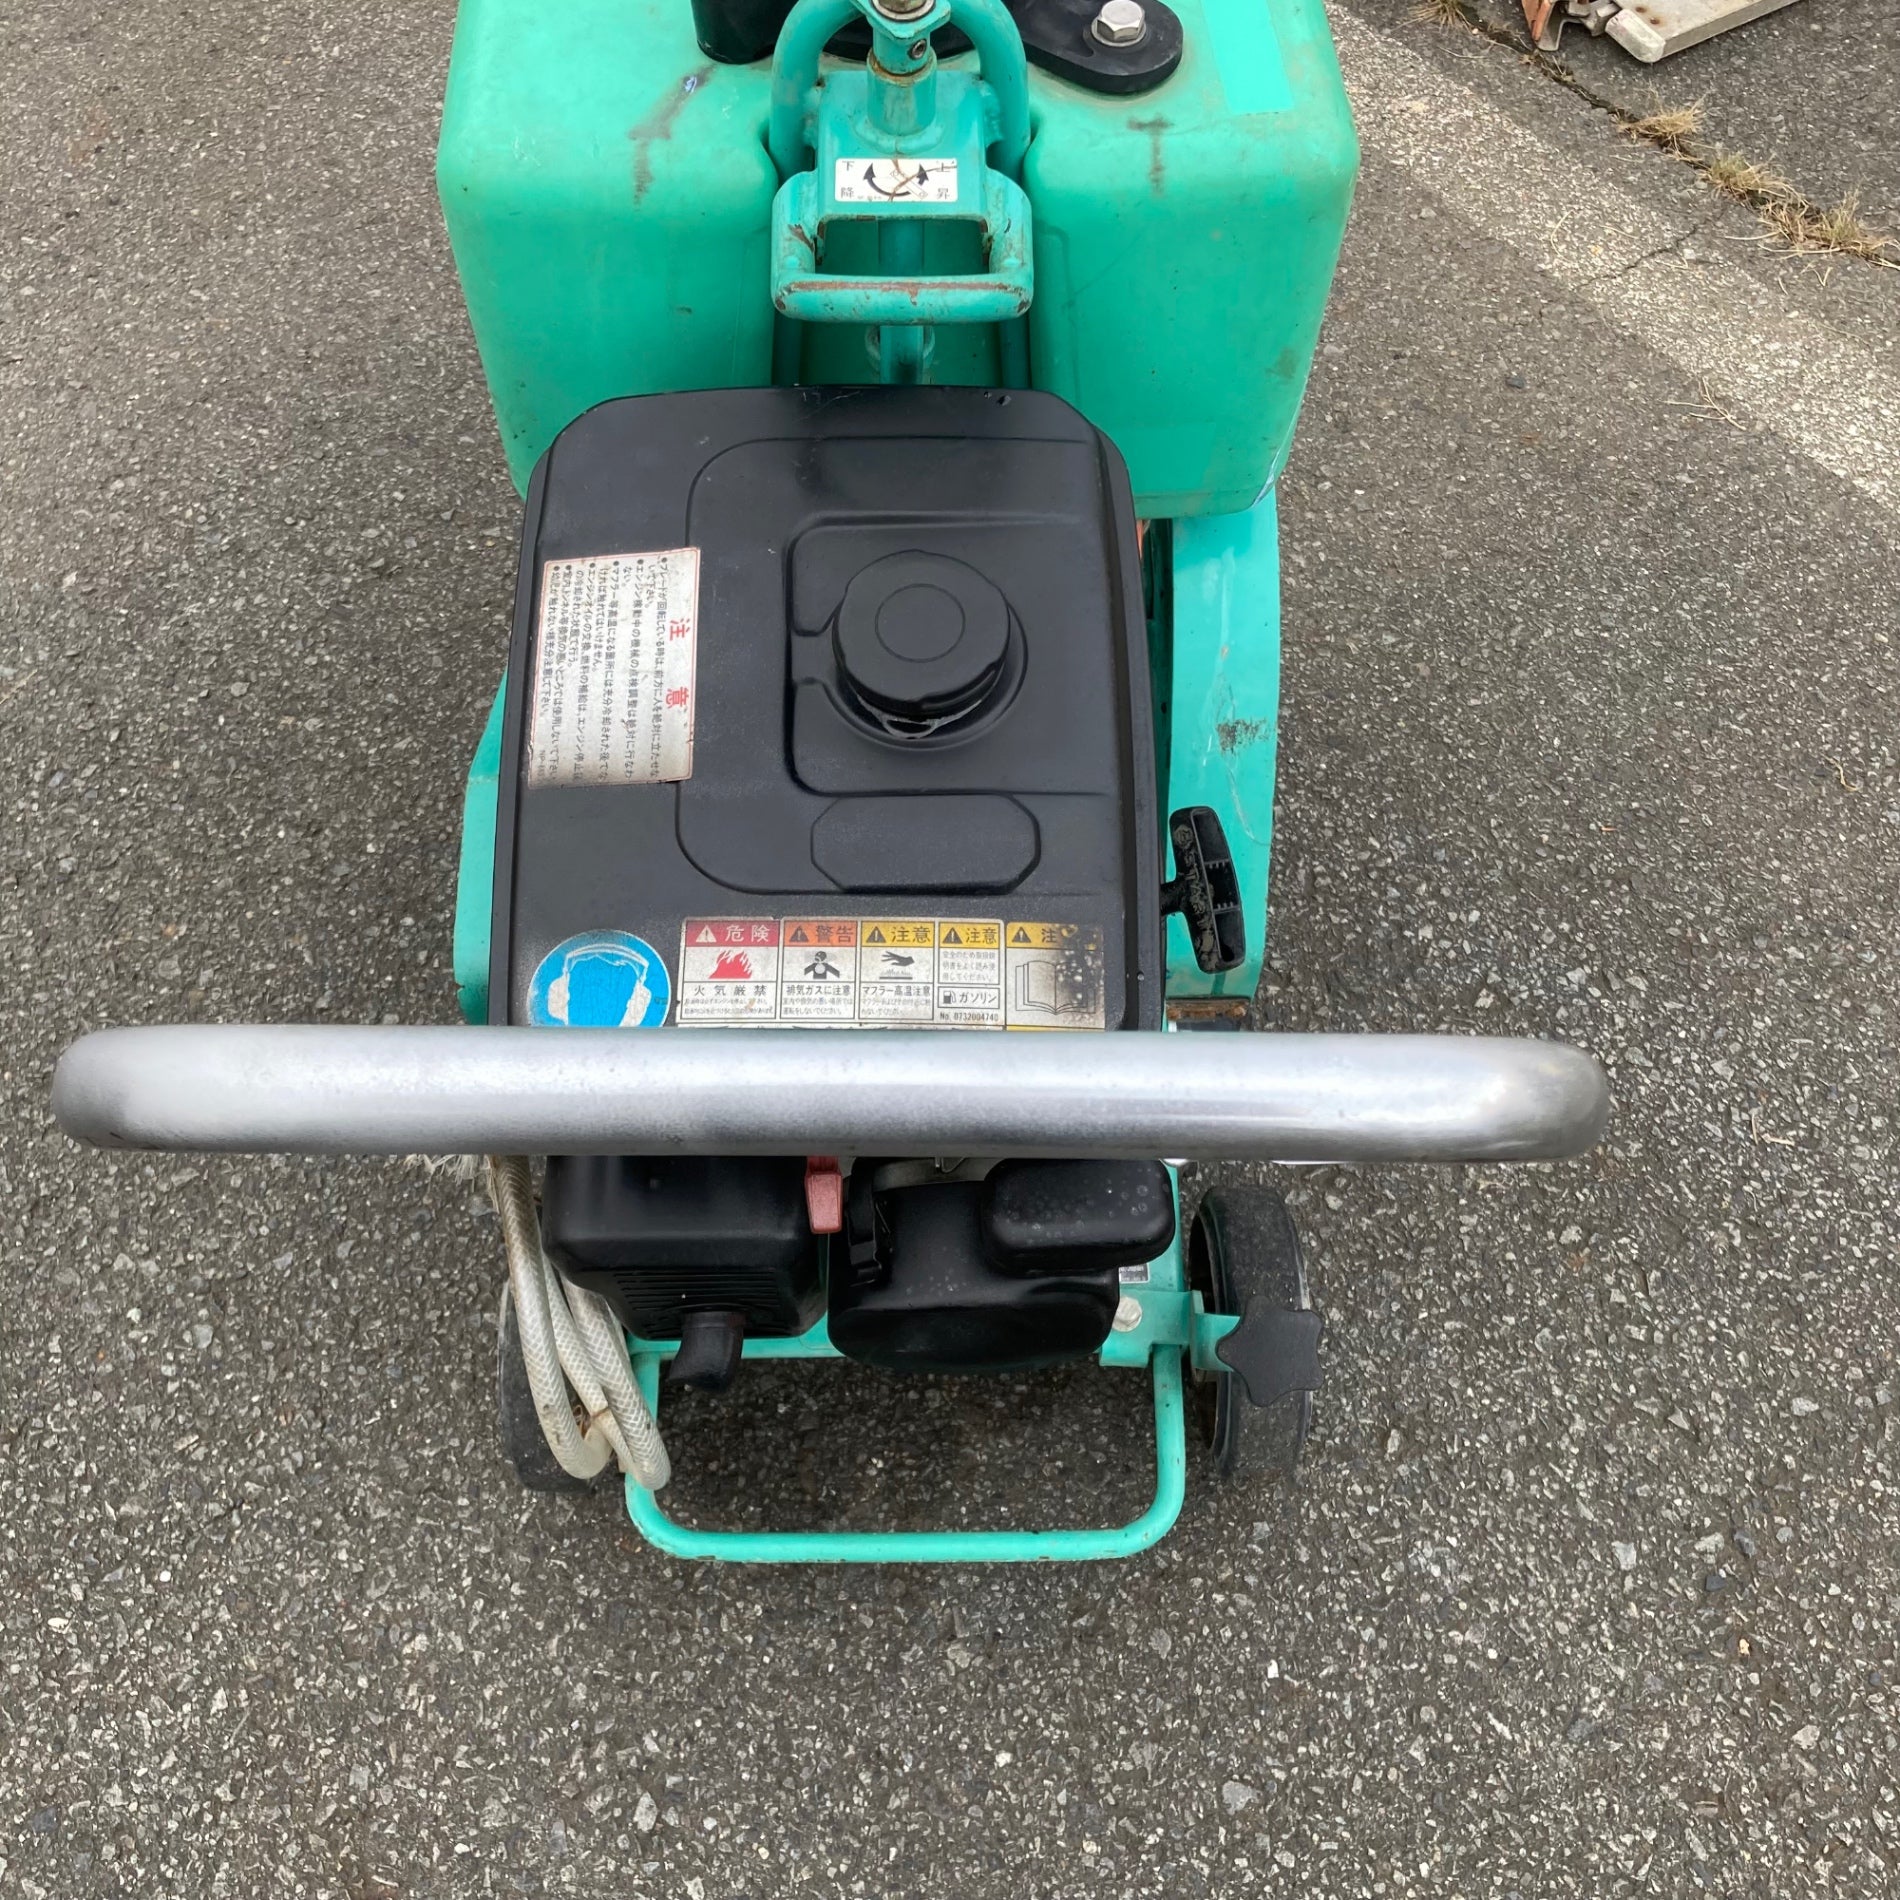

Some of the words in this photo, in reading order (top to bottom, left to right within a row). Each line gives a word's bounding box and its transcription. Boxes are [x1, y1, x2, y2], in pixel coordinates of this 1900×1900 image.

[725, 925, 770, 943] 危険
[815, 925, 854, 943] 警告
[891, 926, 930, 943] 注意
[965, 927, 998, 944] 注意
[694, 985, 768, 996] 火気厳禁
[786, 985, 851, 997] 排気ガスに注意
[862, 985, 931, 997] マフラー高温注意
[959, 990, 997, 1003] ガソリン
